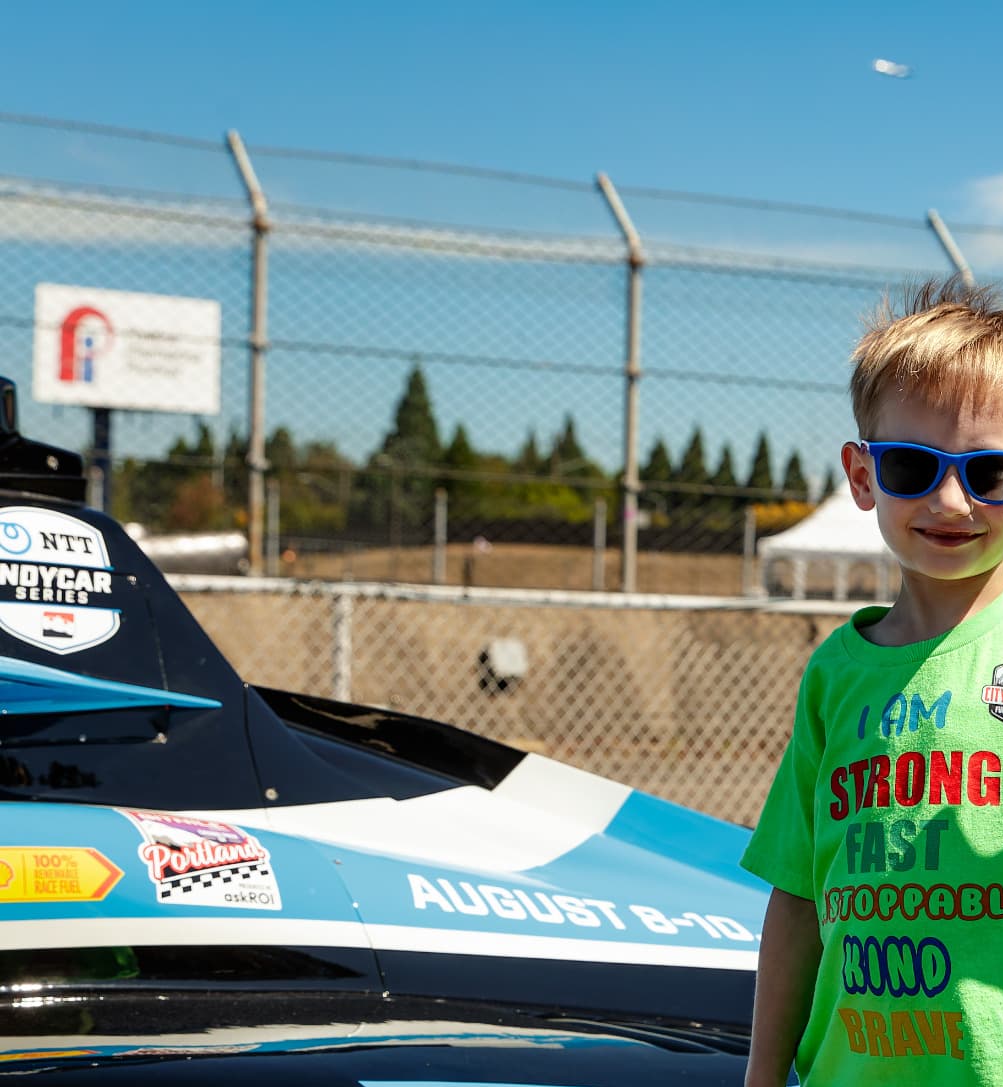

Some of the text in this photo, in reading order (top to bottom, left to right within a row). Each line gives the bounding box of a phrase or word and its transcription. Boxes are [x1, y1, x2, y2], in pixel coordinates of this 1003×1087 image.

[39, 531, 93, 554] NTT
[15, 586, 89, 605] SERIES
[857, 691, 952, 740] I AM
[830, 750, 1002, 821] STRONG
[32, 853, 79, 868] 100%
[145, 837, 264, 880] Portland
[846, 819, 949, 875] FAST
[34, 879, 82, 894] RACE FUEL
[224, 891, 275, 905] askROI
[407, 873, 627, 931] AUGUST
[843, 934, 952, 999] KIND
[838, 1007, 965, 1061] BRAVE
